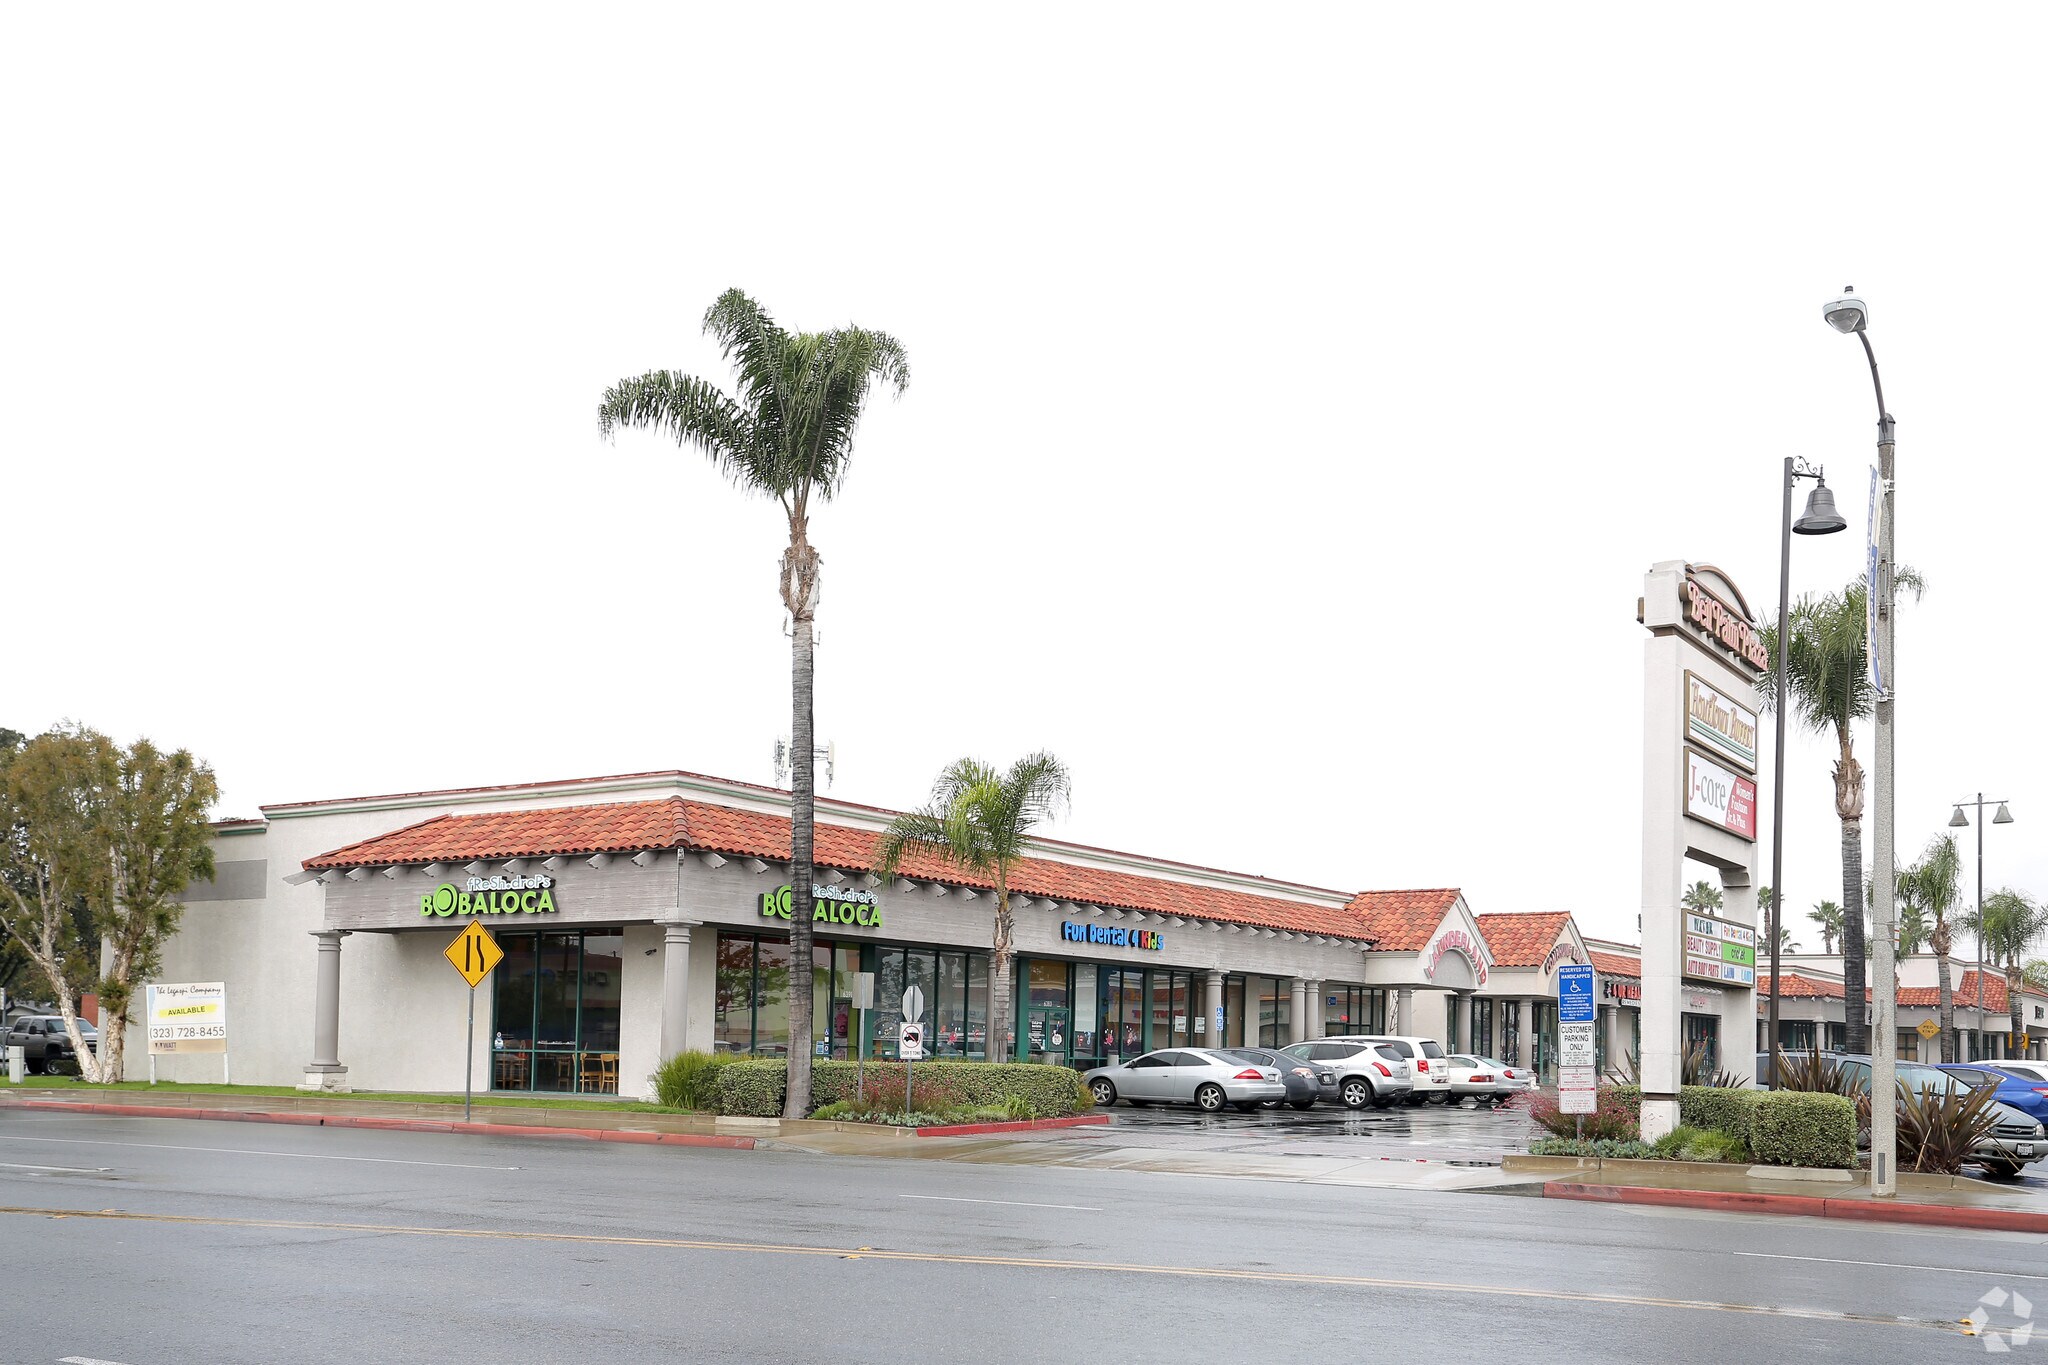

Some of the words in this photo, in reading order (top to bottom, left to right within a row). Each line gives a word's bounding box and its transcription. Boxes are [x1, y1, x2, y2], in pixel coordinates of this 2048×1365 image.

[1687, 580, 1713, 632] Bell
[1712, 600, 1740, 653] Palm
[1739, 620, 1769, 672] Plaza
[420, 883, 556, 917] BOBALOCA
[1140, 930, 1164, 951] Kids
[1687, 936, 1704, 953] BEAUTY
[1705, 939, 1721, 957] SUPPLY
[1688, 959, 1697, 974] AUTO
[1708, 963, 1720, 978] PARTS
[190, 985, 221, 995] Company
[168, 1005, 206, 1016] AVAILABLE
[149, 1027, 174, 1039] (323)
[177, 1026, 225, 1038] 728-8455
[1561, 1025, 1593, 1034] CUSTOMER
[1564, 1034, 1589, 1042] PARKING
[1570, 1043, 1584, 1051] ONLY
